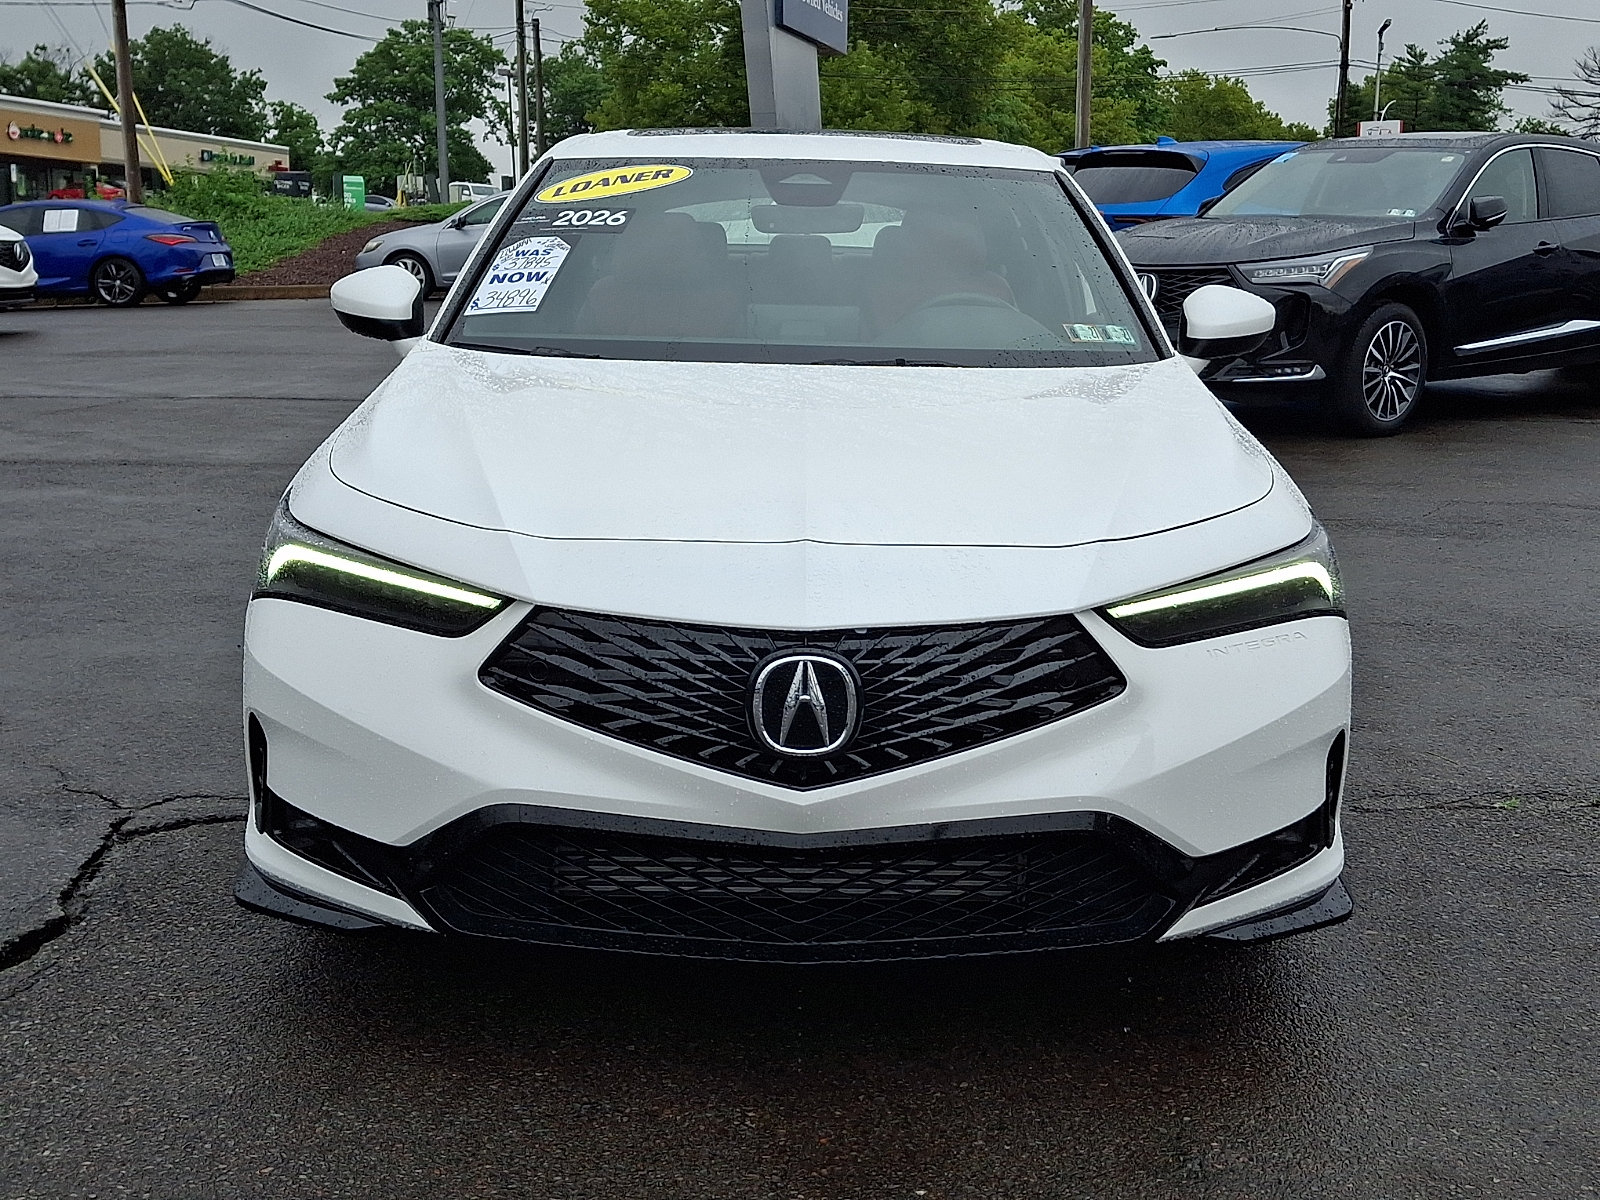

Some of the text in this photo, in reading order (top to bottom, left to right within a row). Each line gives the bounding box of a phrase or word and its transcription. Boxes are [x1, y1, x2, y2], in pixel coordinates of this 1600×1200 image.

[552, 168, 675, 198] LOANER
[552, 210, 628, 226] 2026
[514, 248, 553, 257] WAS
[488, 270, 549, 285] NOW
[1206, 631, 1308, 658] INTEGRA
